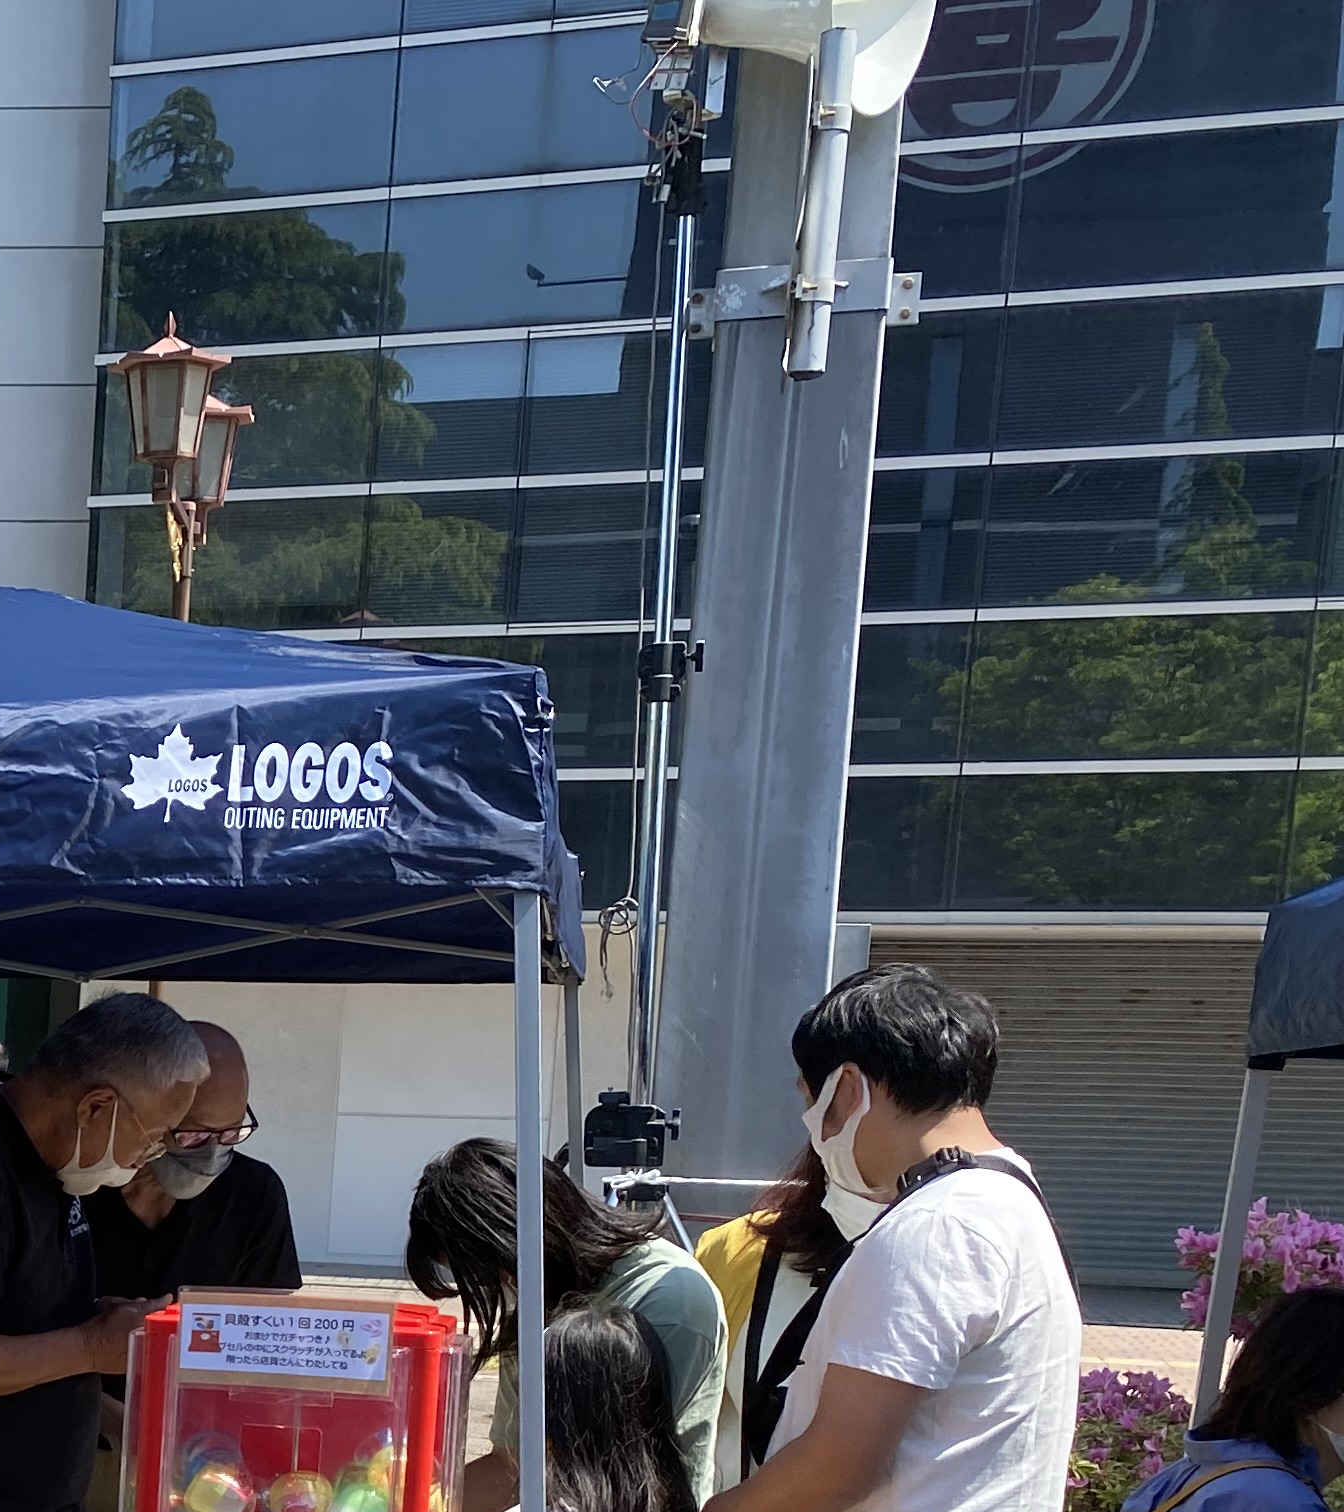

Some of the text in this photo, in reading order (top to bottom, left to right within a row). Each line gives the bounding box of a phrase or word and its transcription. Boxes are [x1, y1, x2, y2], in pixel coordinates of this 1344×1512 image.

[226, 740, 394, 803] LOGOS
[167, 778, 208, 793] LOGOS
[223, 806, 390, 830] OUTING EQUIPMENT
